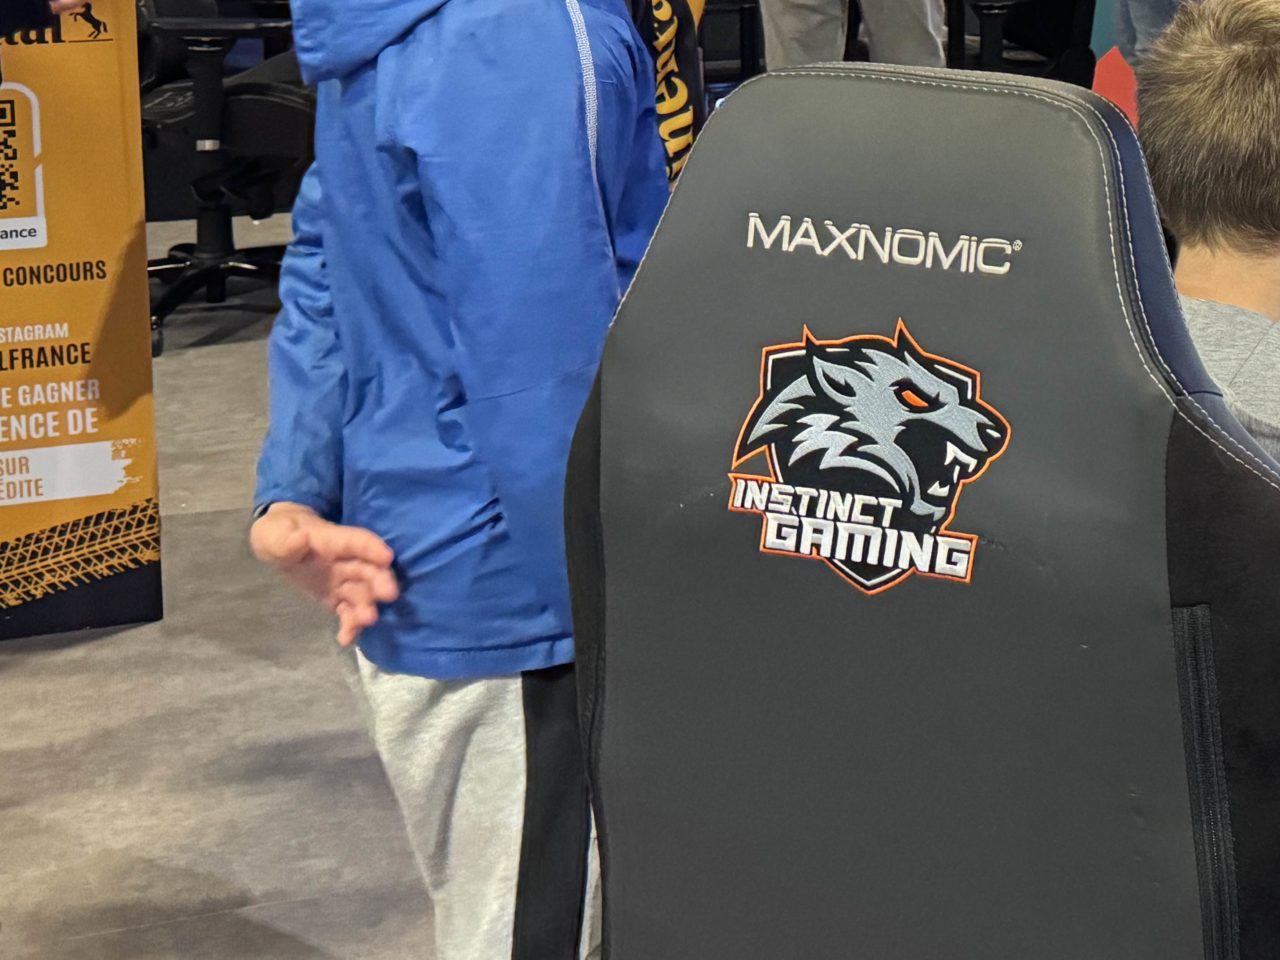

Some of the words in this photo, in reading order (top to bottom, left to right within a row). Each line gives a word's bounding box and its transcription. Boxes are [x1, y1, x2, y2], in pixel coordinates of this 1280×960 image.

[3, 260, 107, 287] CONCOURS
[18, 379, 100, 407] GAGNER
[67, 407, 98, 435] DE
[733, 477, 903, 529] INSTINCT
[764, 511, 972, 578] GAMING
